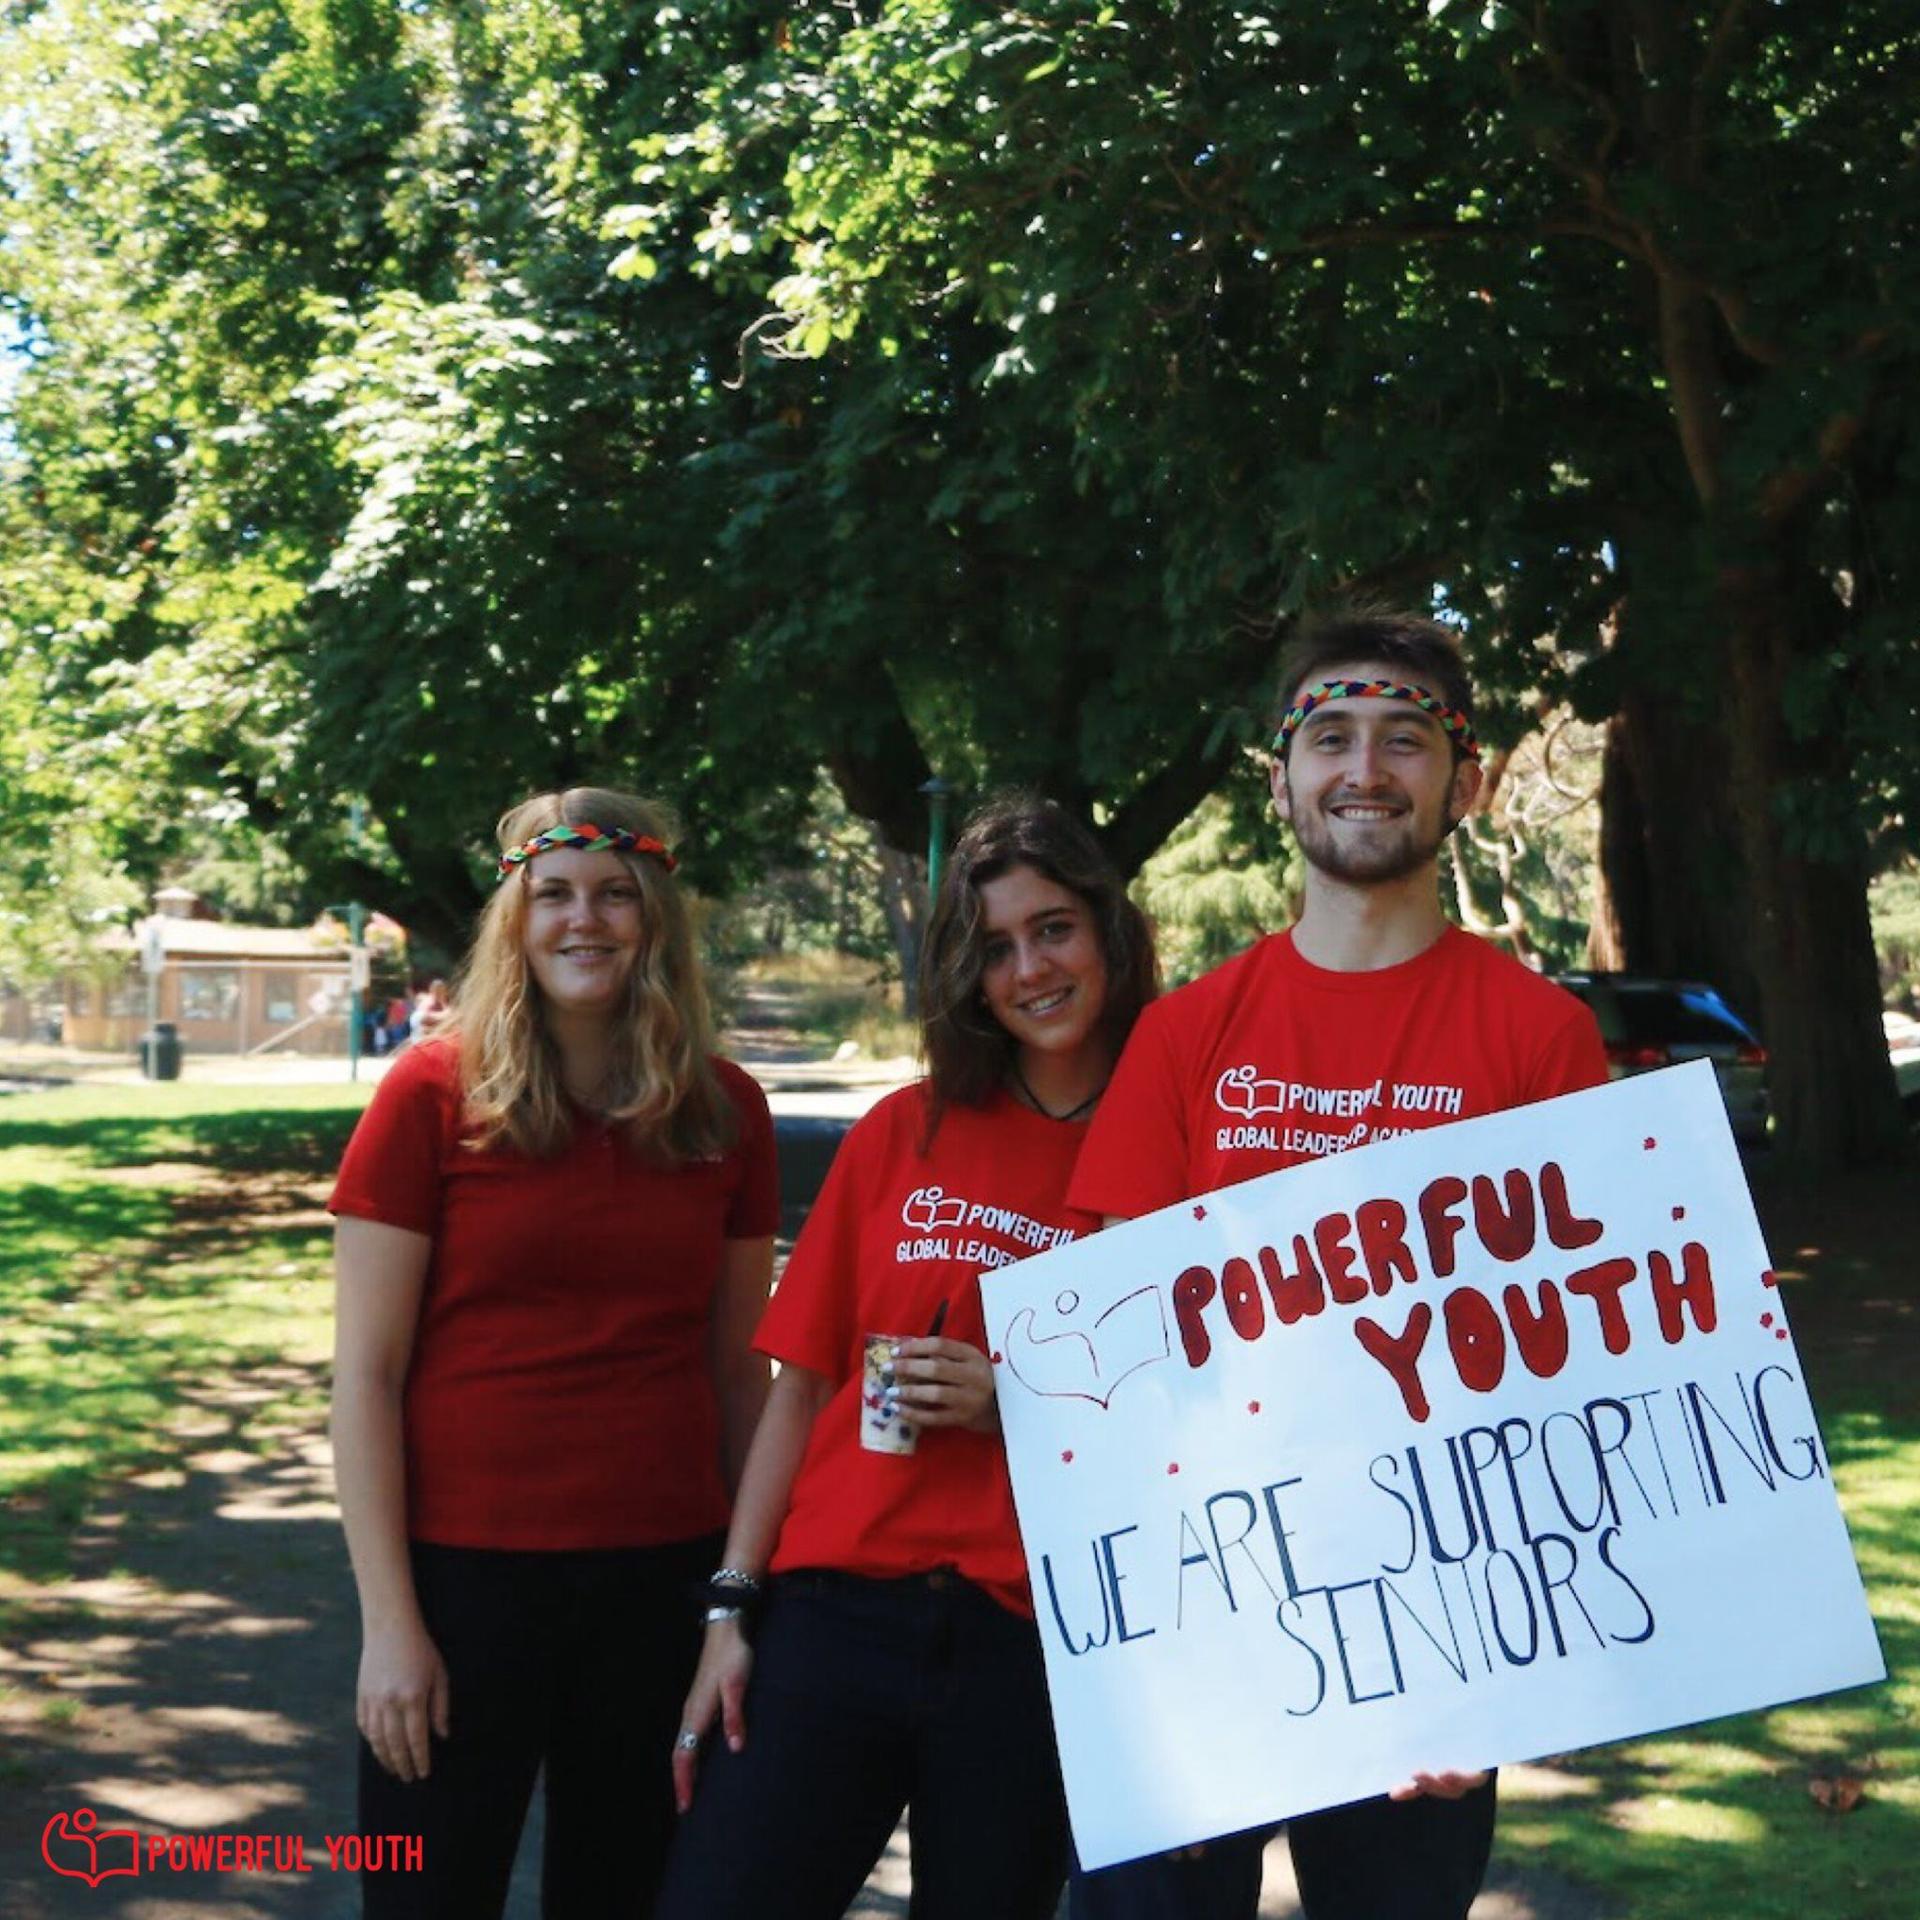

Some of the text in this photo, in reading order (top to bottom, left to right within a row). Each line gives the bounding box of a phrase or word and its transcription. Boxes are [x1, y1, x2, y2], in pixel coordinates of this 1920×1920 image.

[1216, 1126, 1279, 1151] GLOBAL
[1288, 1079, 1463, 1118] POWERFL YOUTH
[896, 1237, 952, 1263] GLOBAL
[1172, 1161, 1603, 1369] POWERFUL
[1354, 1242, 1718, 1423] YOUTH
[1042, 1366, 1825, 1656] WE ARE SUPPORTING
[1276, 1526, 1655, 1718] SENIORS
